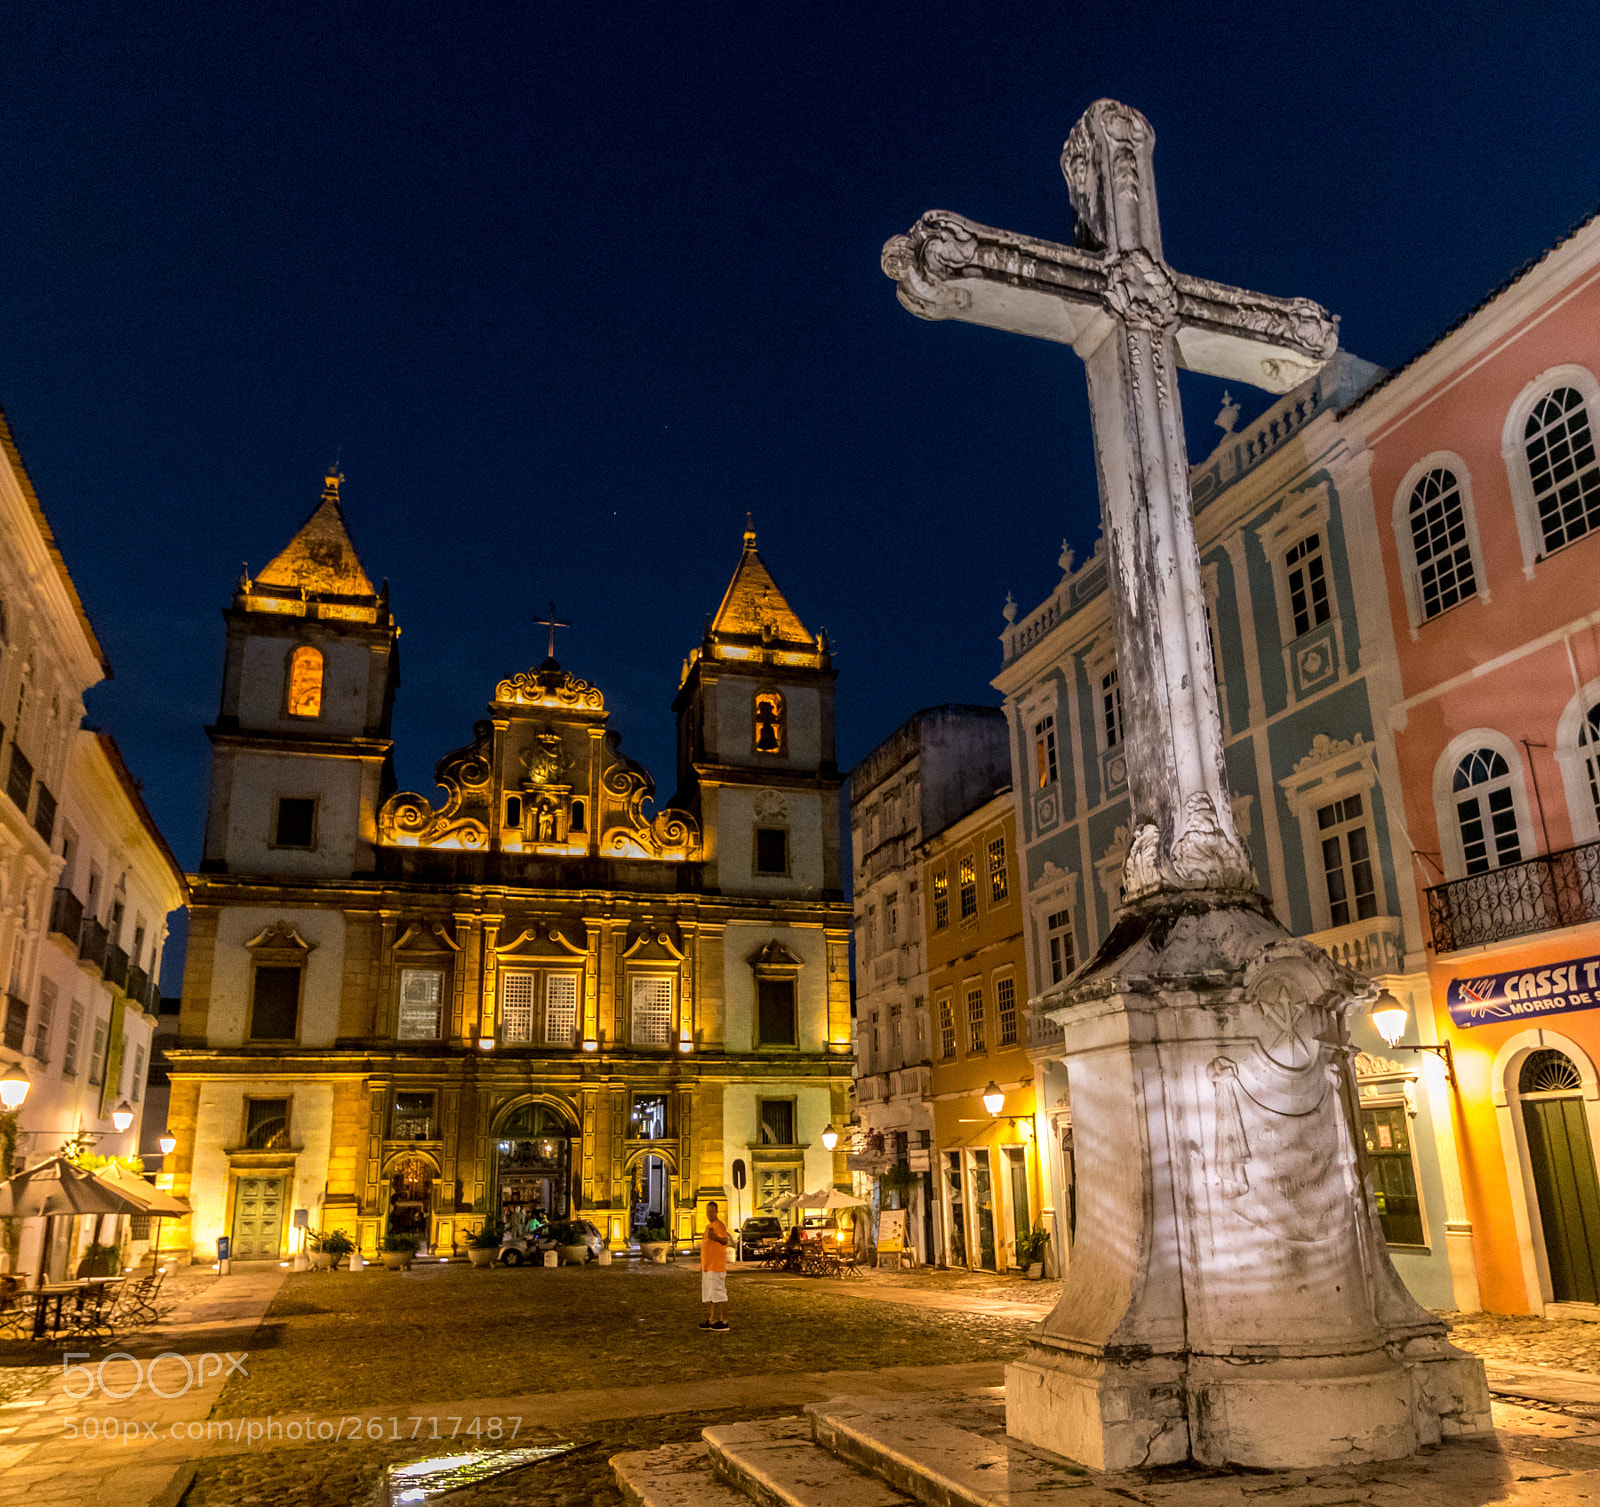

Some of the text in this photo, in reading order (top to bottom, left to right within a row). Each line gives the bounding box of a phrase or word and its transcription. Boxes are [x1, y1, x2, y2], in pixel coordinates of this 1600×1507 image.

[1504, 961, 1600, 1003] CASSI T
[1509, 997, 1566, 1015] MORRO
[1568, 992, 1592, 1005] DE
